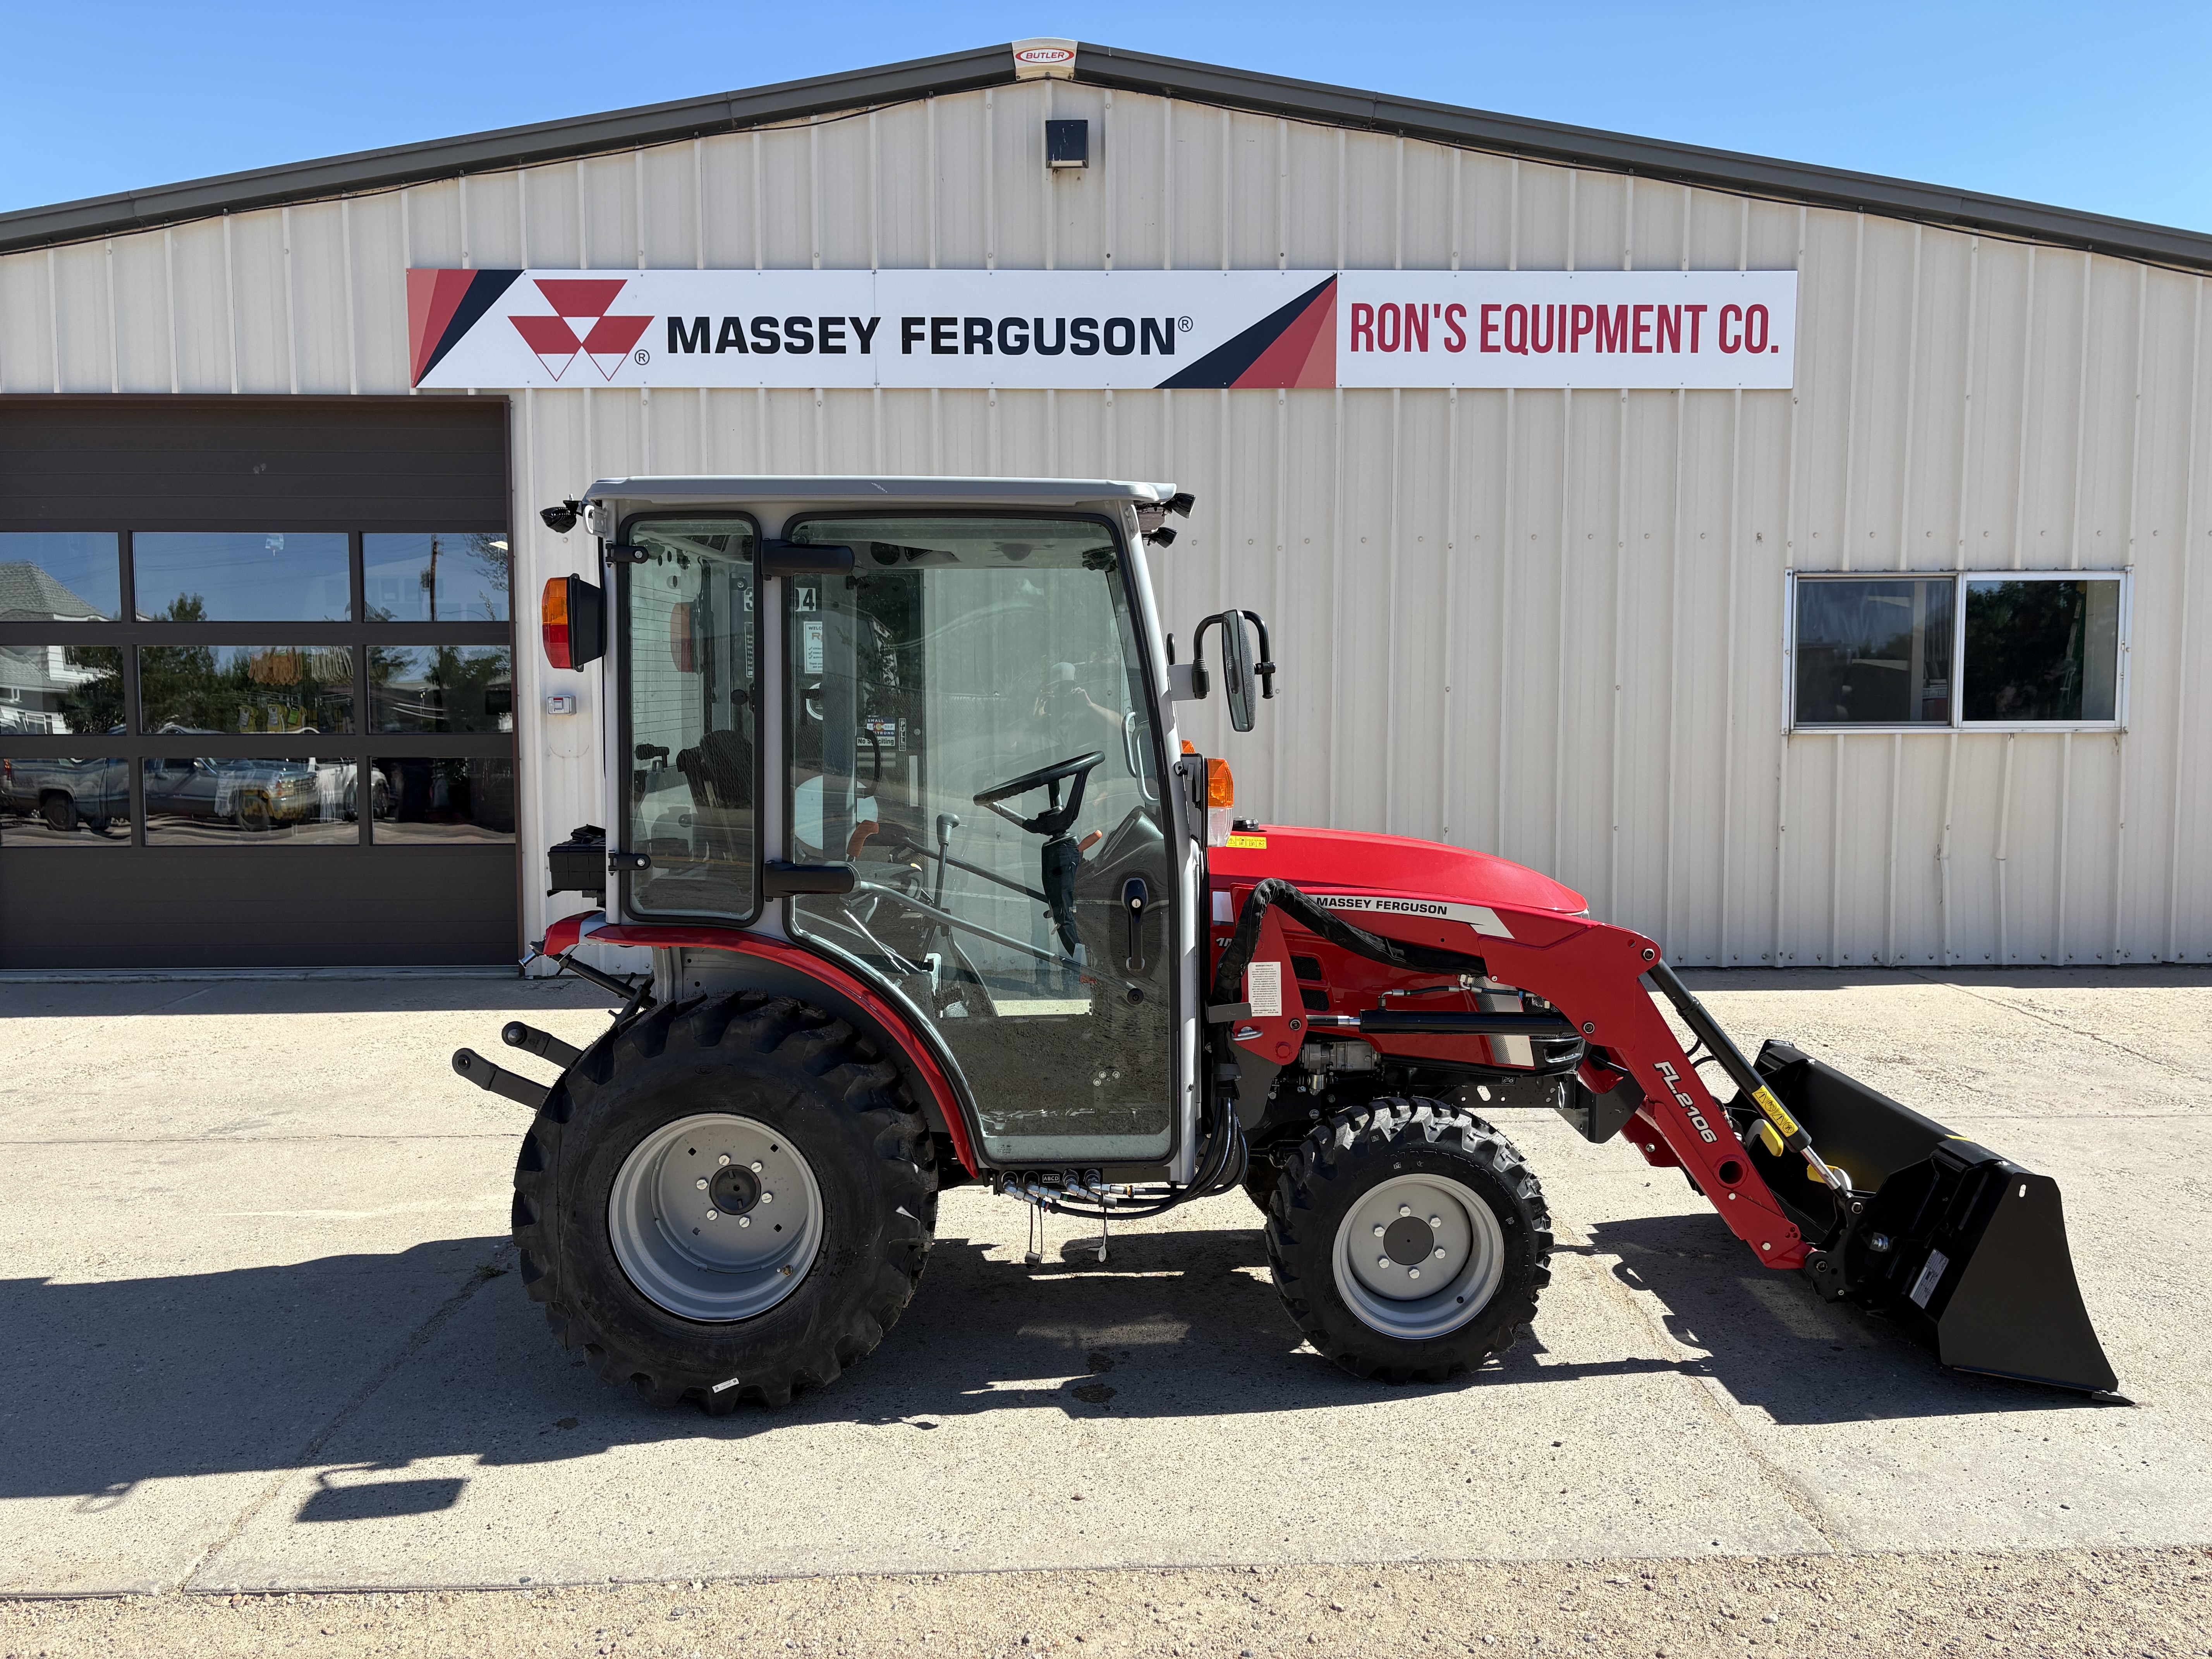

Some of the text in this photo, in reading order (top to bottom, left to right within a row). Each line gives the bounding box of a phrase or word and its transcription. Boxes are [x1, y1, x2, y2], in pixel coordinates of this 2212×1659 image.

[667, 316, 881, 355] MASSEY
[1350, 302, 1779, 357] RON'S EQUIPMENT CO.
[1316, 897, 1448, 916] MASSEY FERGUSON
[1652, 1061, 1718, 1144] FL.2106
